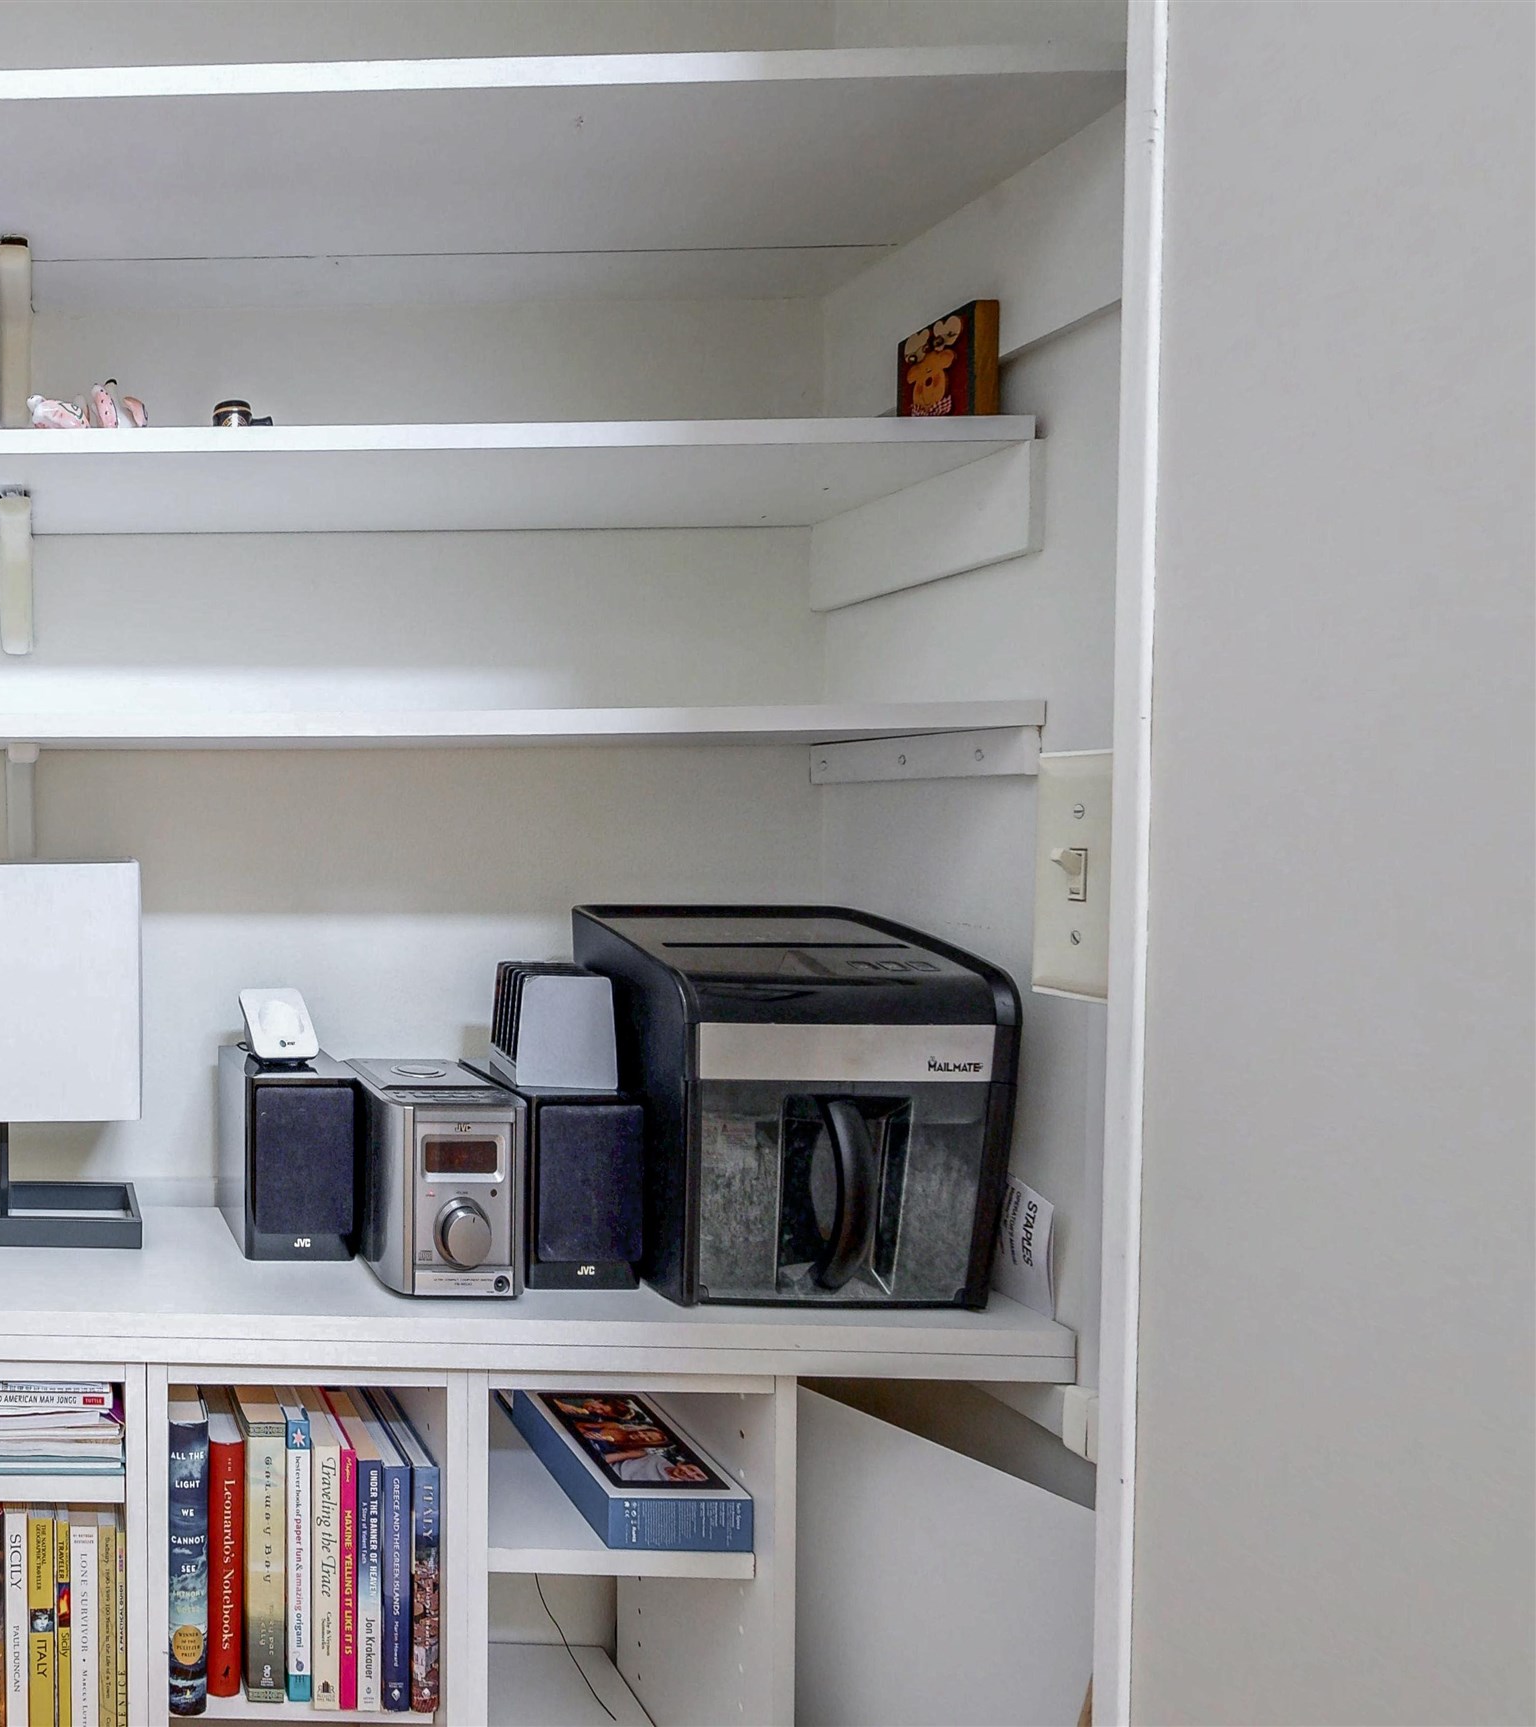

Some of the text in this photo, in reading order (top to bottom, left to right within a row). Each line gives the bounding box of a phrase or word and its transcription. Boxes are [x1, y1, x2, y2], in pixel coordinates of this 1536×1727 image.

[928, 1061, 979, 1072] MAILMATE
[455, 1123, 472, 1132] JVC
[294, 1238, 311, 1247] JVC
[1022, 1201, 1038, 1267] STAPLES
[577, 1266, 595, 1275] JVC
[4, 1395, 38, 1403] AMERICAN
[39, 1396, 54, 1404] MAH
[56, 1396, 77, 1404] JONGG
[171, 1452, 204, 1460] ALL THE
[175, 1480, 200, 1489] LIGHT
[392, 1478, 400, 1511] GREECE
[181, 1509, 194, 1517] WE
[392, 1512, 400, 1530] AND
[422, 1484, 434, 1541] ITALY
[171, 1535, 205, 1545] CANNOT
[294, 1518, 302, 1545] paper
[316, 1457, 337, 1598] Traveling the Trace
[369, 1470, 378, 1598] UNDER THE BANNER OF HEAVEN
[392, 1532, 400, 1548] THE
[10, 1534, 22, 1590] SICILY
[221, 1480, 235, 1649] Leonardo's Notebooks
[295, 1548, 303, 1563] fun
[392, 1550, 400, 1578] GREEK
[80, 1553, 88, 1586] LONE
[181, 1565, 196, 1573] SEE
[344, 1553, 353, 1596] YELLING
[294, 1573, 303, 1611] amazing
[344, 1598, 353, 1607] IT
[392, 1580, 400, 1615] ISLANDS
[80, 1591, 88, 1652] SURVIVOR
[294, 1613, 303, 1648] origami
[344, 1609, 353, 1632] LIKE
[60, 1633, 70, 1656] Sicily
[344, 1634, 353, 1643] IT
[344, 1645, 353, 1654] IS
[365, 1617, 376, 1679] Jon Krakauer
[37, 1639, 47, 1678] ITALY
[13, 1651, 21, 1692] DUNCAN
